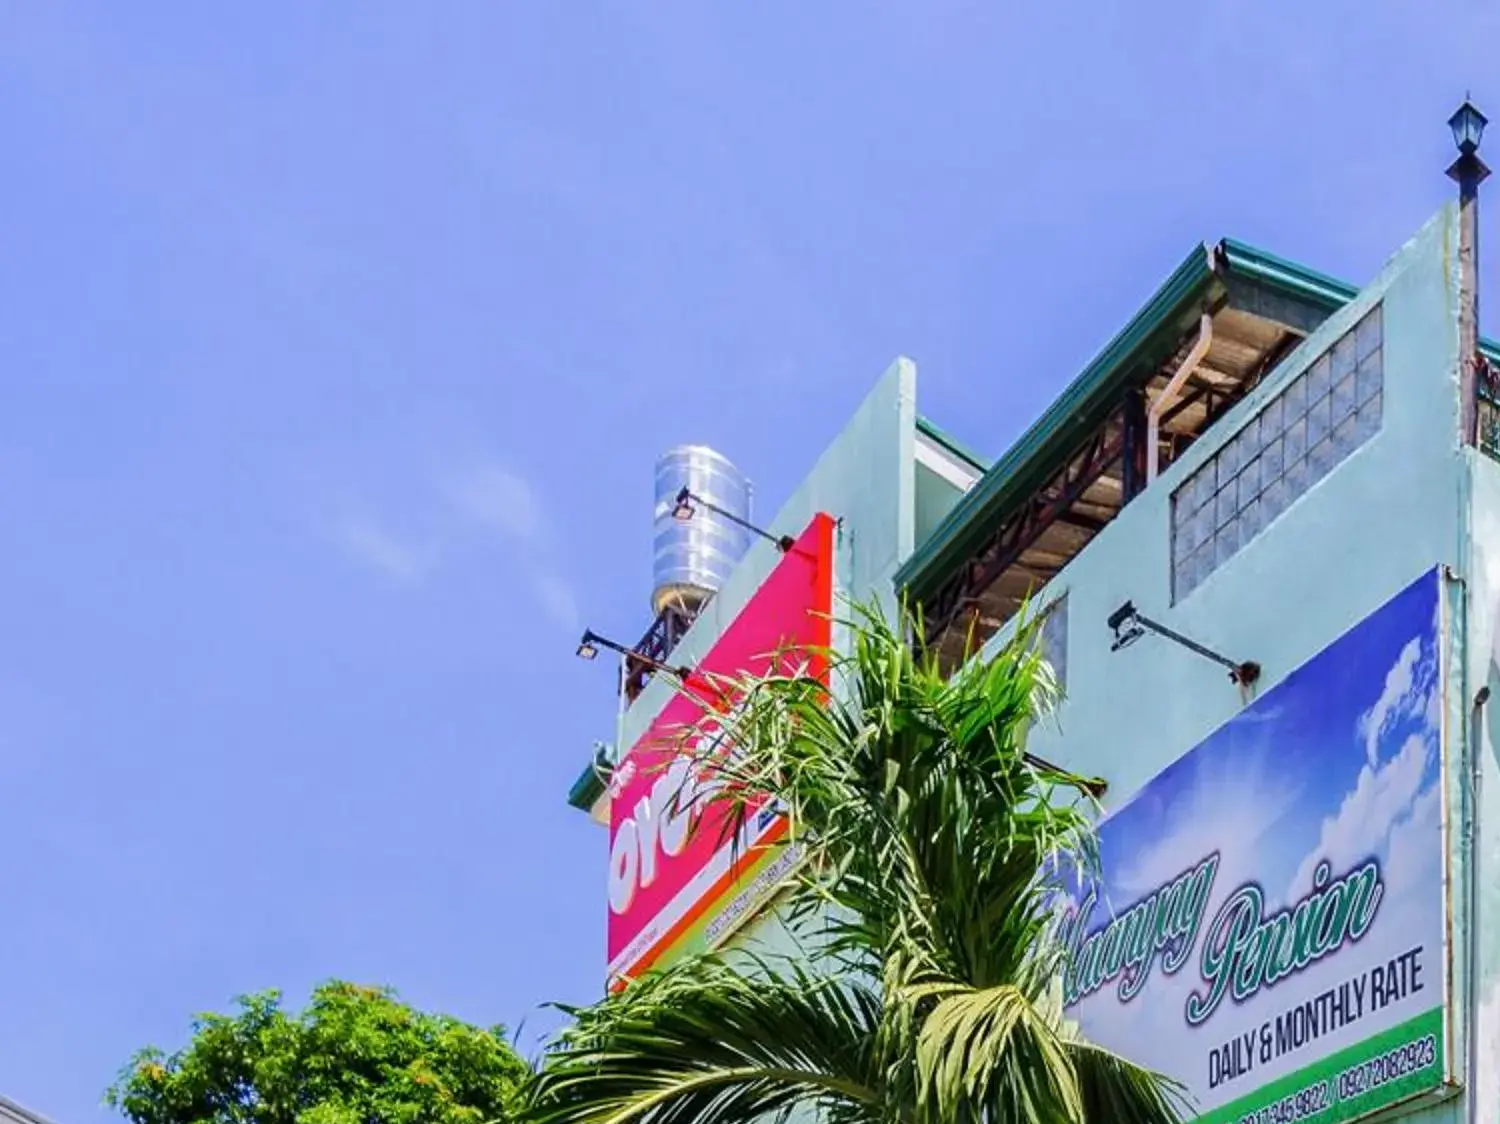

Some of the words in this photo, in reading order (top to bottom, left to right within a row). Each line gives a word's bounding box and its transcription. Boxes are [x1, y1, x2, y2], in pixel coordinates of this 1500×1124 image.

[608, 755, 698, 914] OYO
[1188, 858, 1384, 1026] Pension
[1209, 1030, 1257, 1089] DAILY
[1260, 1021, 1273, 1064] &
[1275, 973, 1367, 1058] MONTHLY
[1371, 946, 1424, 1012] RATE
